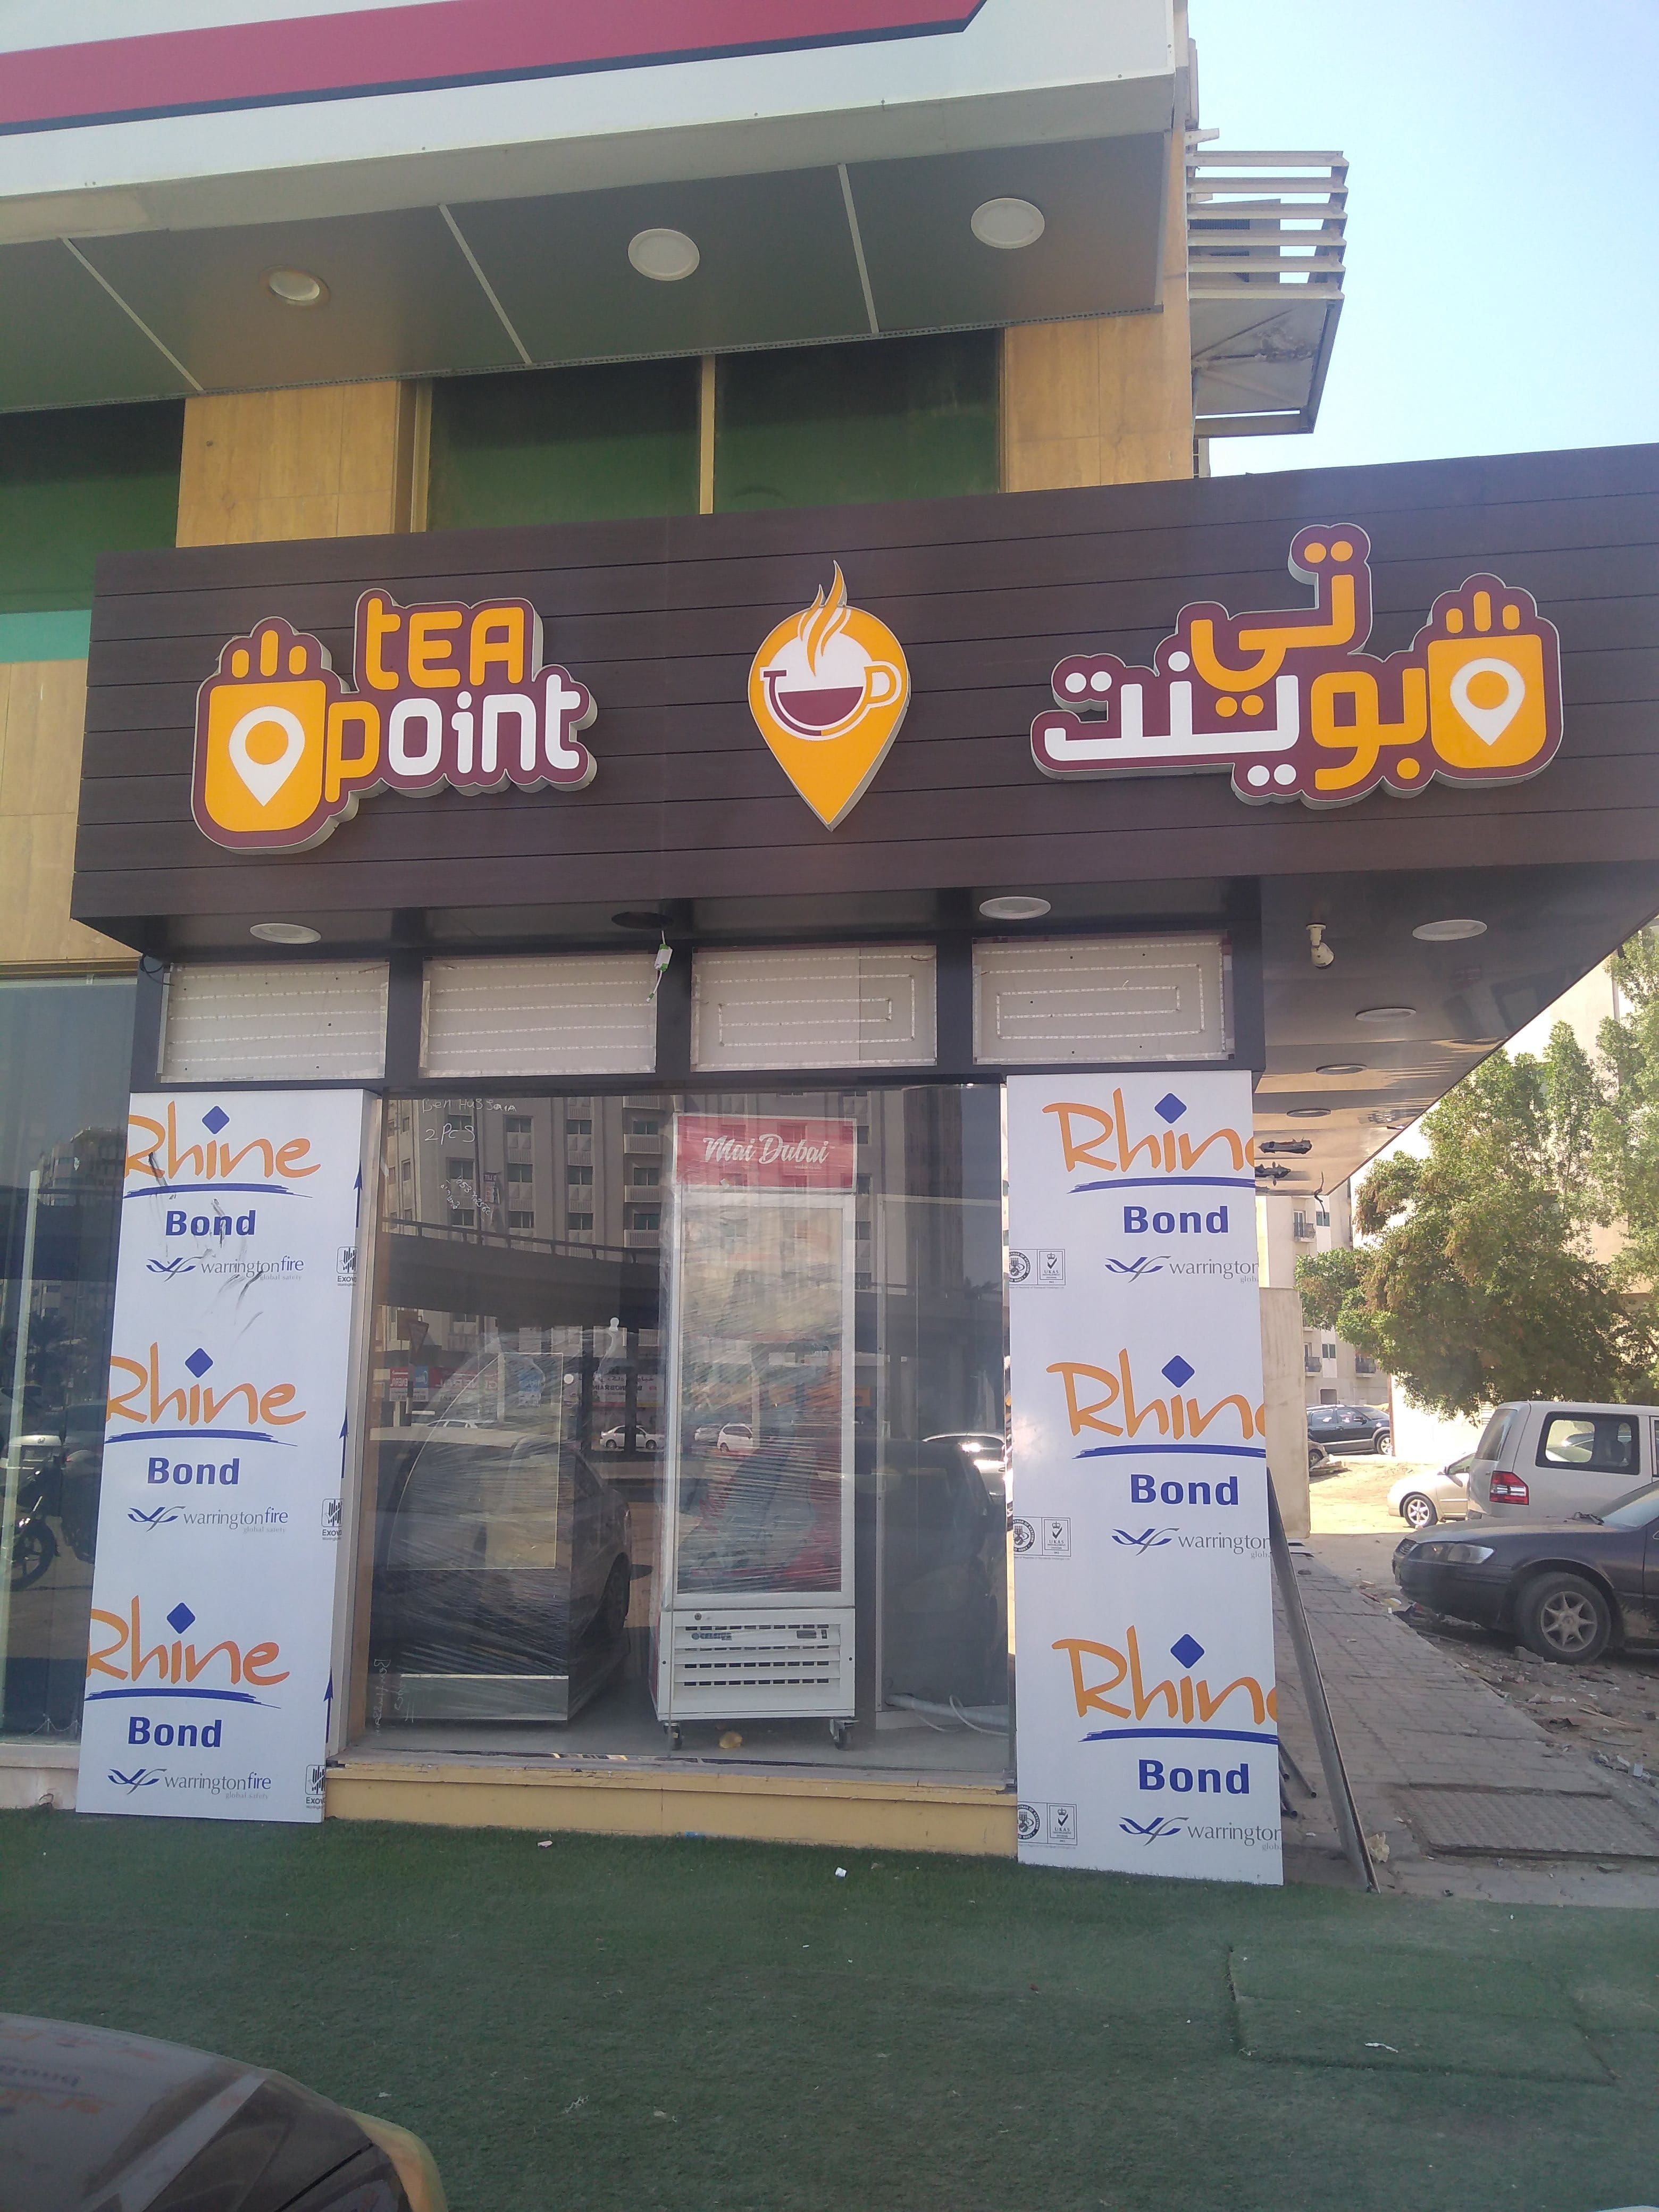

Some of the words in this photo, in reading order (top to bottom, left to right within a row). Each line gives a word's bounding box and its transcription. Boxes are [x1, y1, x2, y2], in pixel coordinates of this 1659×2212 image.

[1044, 650, 1426, 790] بوينت
[324, 673, 581, 803] point
[123, 1100, 321, 1180] Rhine
[1042, 1087, 1255, 1174] Rhin
[702, 1135, 756, 1163] Mai
[758, 1133, 830, 1164] Dubai
[165, 1209, 256, 1236] Bond
[1123, 1205, 1229, 1234] Bond
[201, 1255, 304, 1278] warringtonfire
[106, 1341, 307, 1426] Rhine
[1046, 1347, 1266, 1440] Rhin
[147, 1456, 240, 1485] Bond
[1130, 1473, 1239, 1505] Bond
[183, 1506, 289, 1530] warringtonfire
[86, 1594, 290, 1686] Rhine
[1051, 1624, 1277, 1725] Rhin
[127, 1715, 223, 1748] Bond
[164, 1771, 272, 1795] warringtonfire
[1138, 1758, 1250, 1795] Bond
